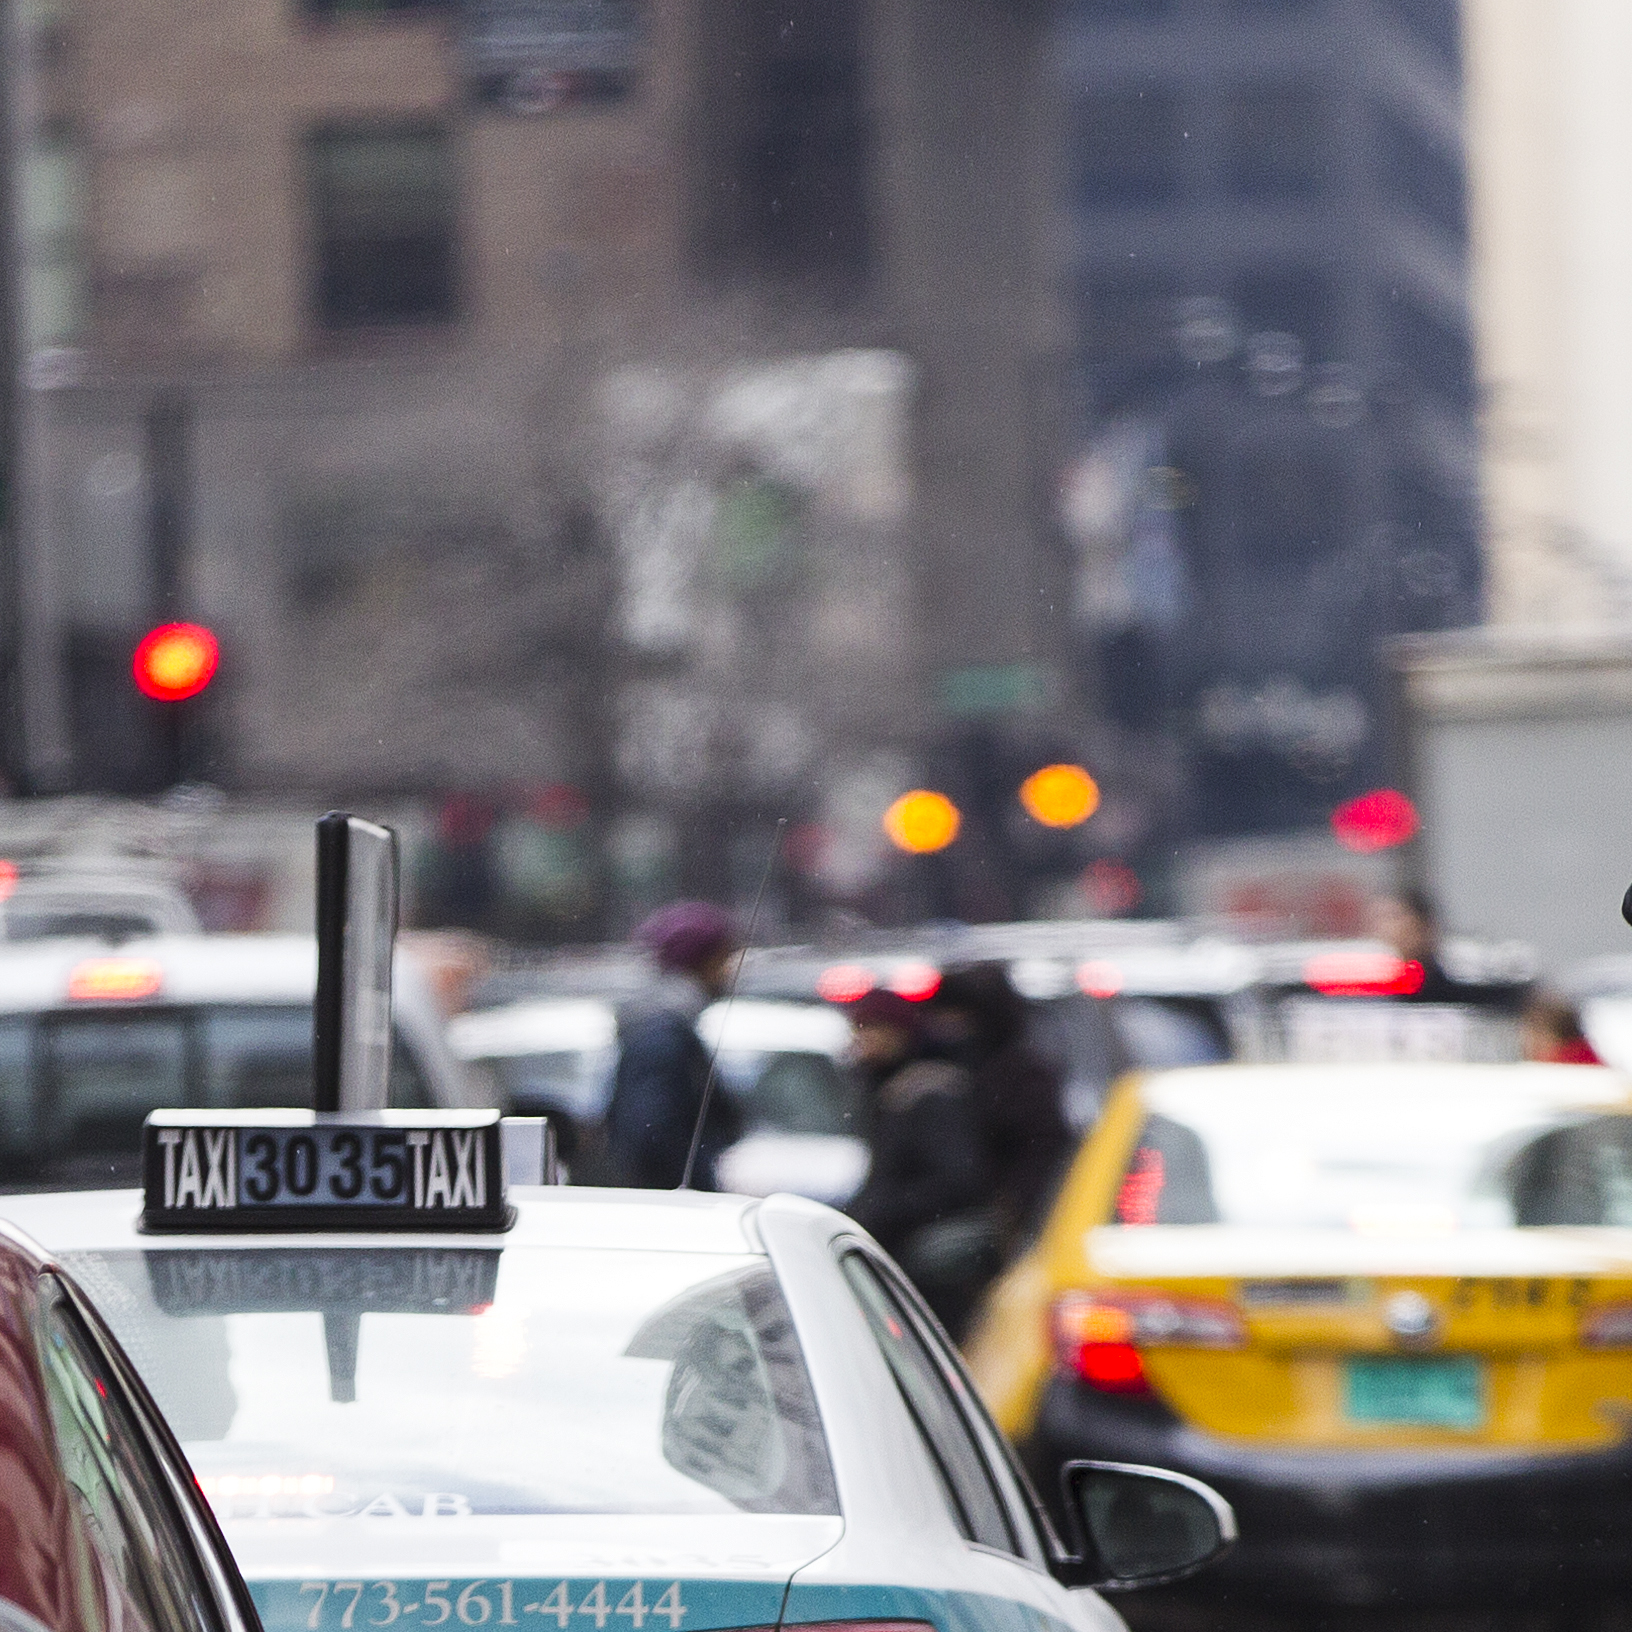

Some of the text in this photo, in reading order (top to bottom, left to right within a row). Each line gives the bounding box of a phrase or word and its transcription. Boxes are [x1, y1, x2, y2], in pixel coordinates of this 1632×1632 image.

[157, 1128, 487, 1210] TAXI 3035 TAXI
[298, 1579, 688, 1629] 773-561-4444
